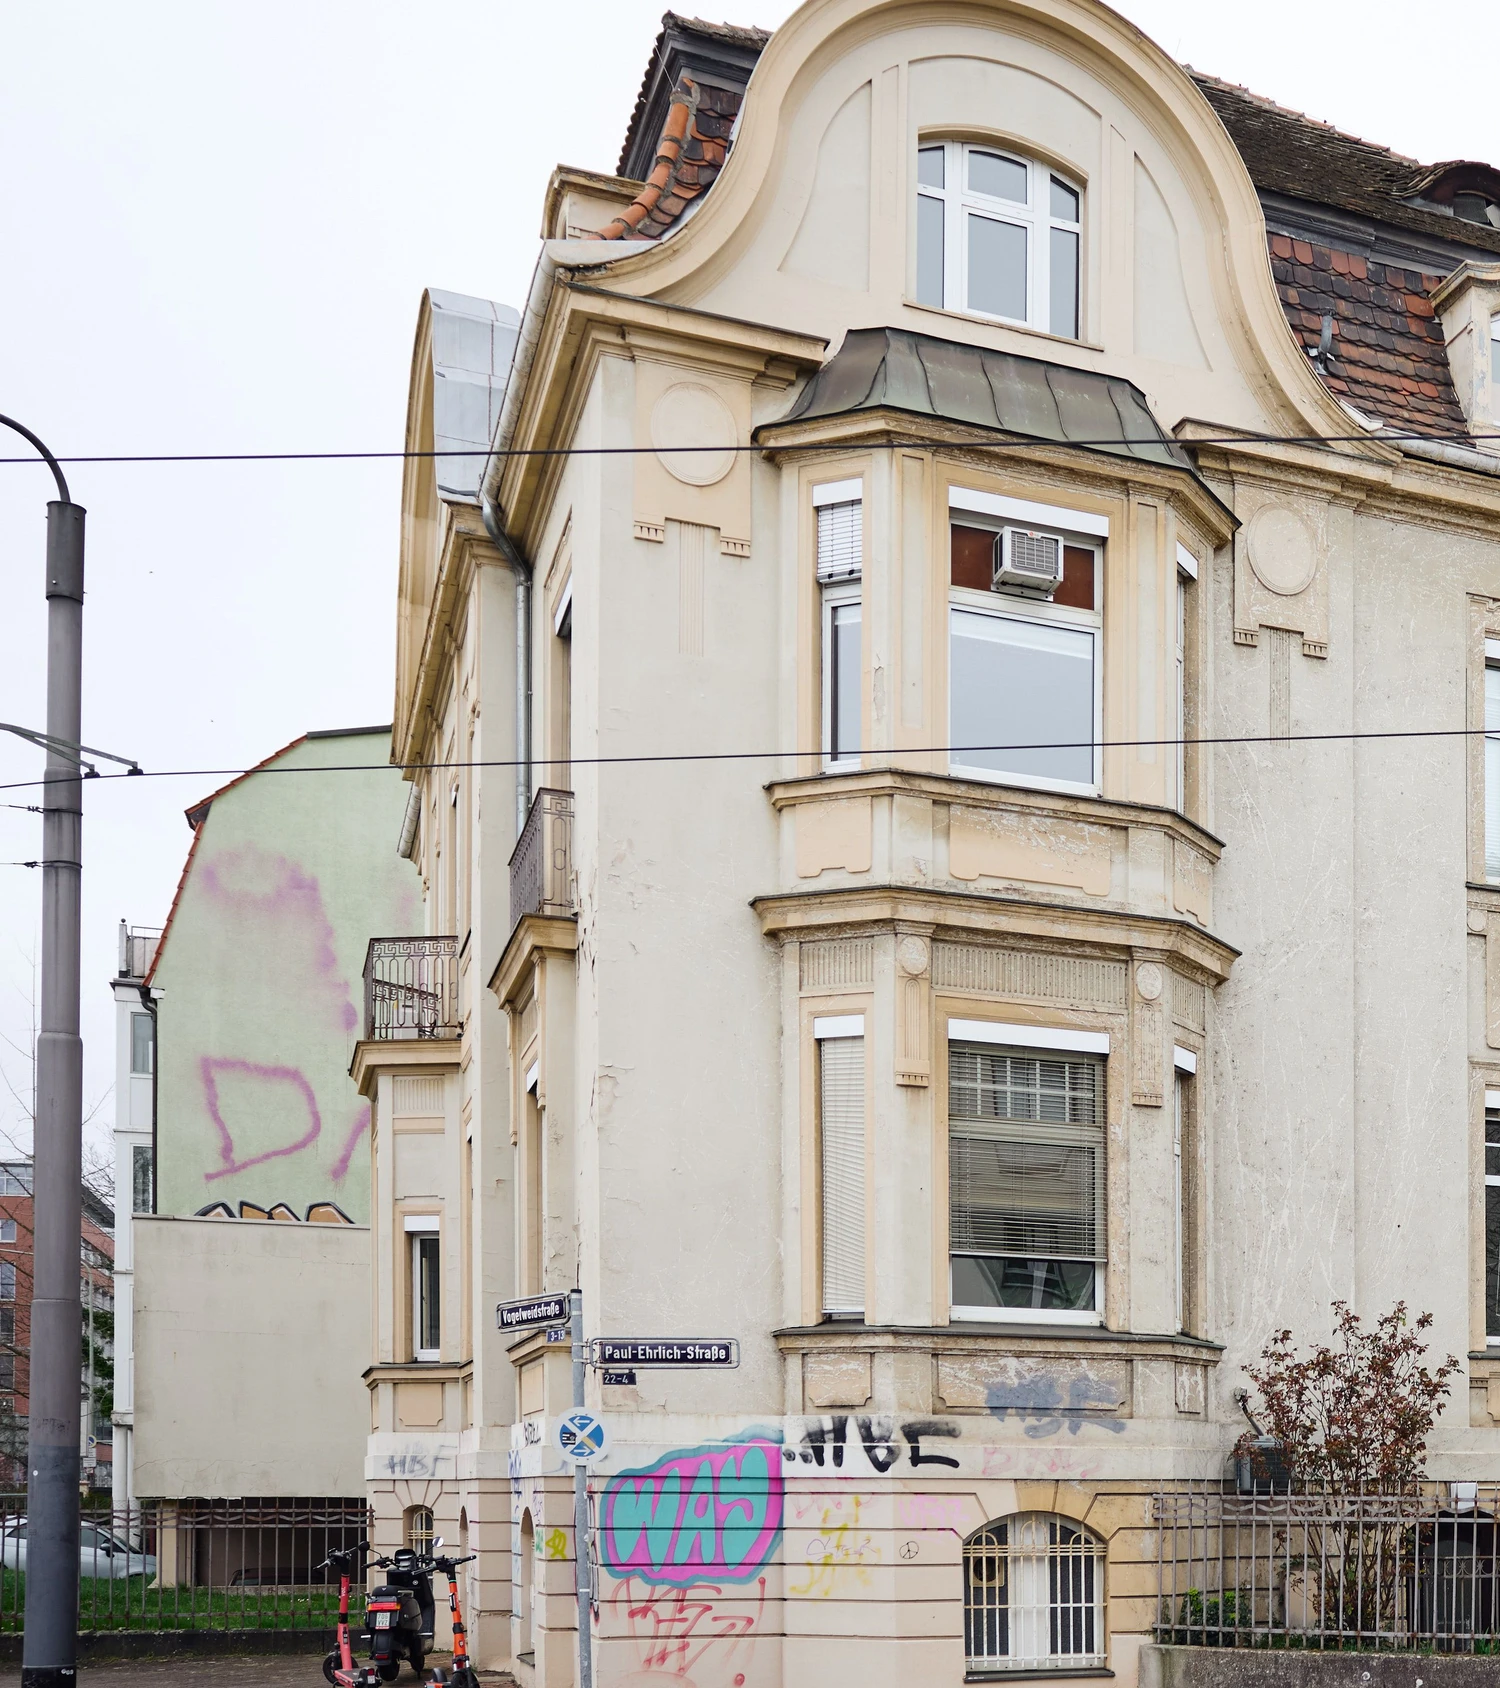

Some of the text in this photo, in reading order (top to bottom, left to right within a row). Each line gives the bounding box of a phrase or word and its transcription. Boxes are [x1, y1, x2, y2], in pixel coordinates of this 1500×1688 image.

[502, 1303, 560, 1325] Vogelweidstraße
[550, 1330, 565, 1341] 3-13
[604, 1345, 726, 1362] Paul-Ehrlich-Straße
[604, 1374, 629, 1385] 22-4
